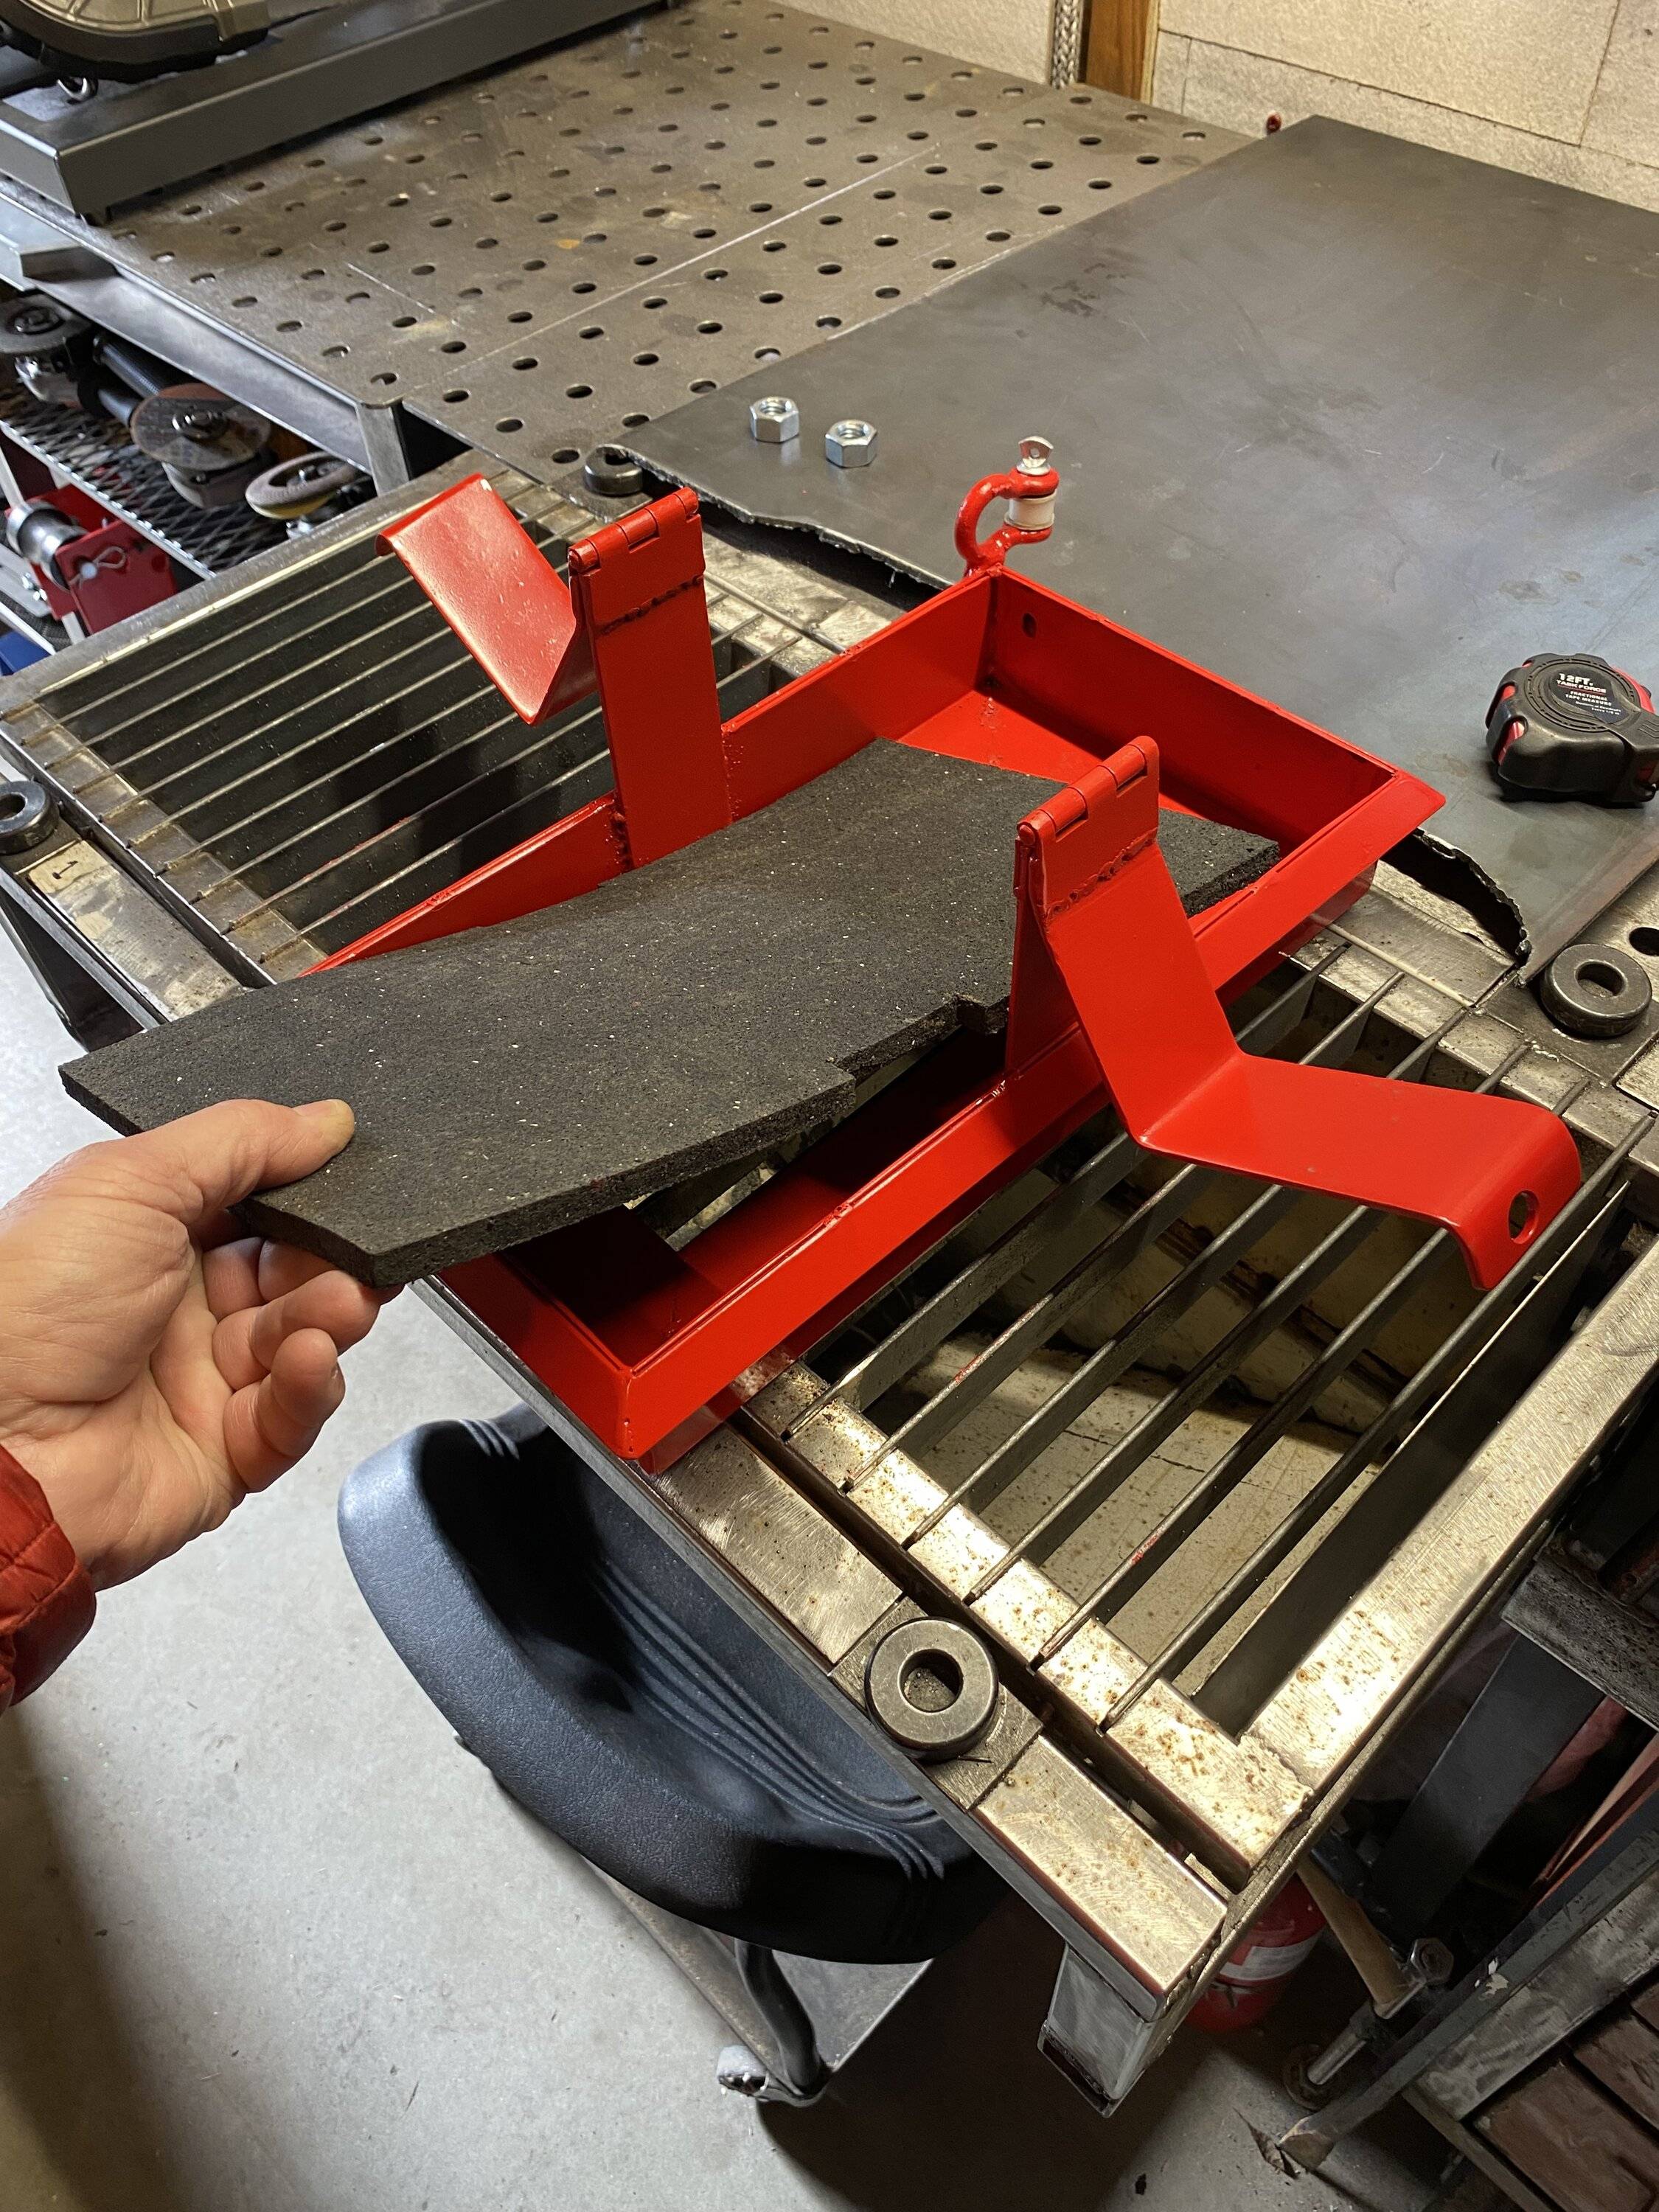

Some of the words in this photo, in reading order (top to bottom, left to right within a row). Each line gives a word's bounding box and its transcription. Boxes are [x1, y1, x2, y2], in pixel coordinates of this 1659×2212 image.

[1557, 679, 1578, 688] TASK
[1579, 685, 1607, 693] FORCE
[1582, 697, 1612, 706] MEASURE
